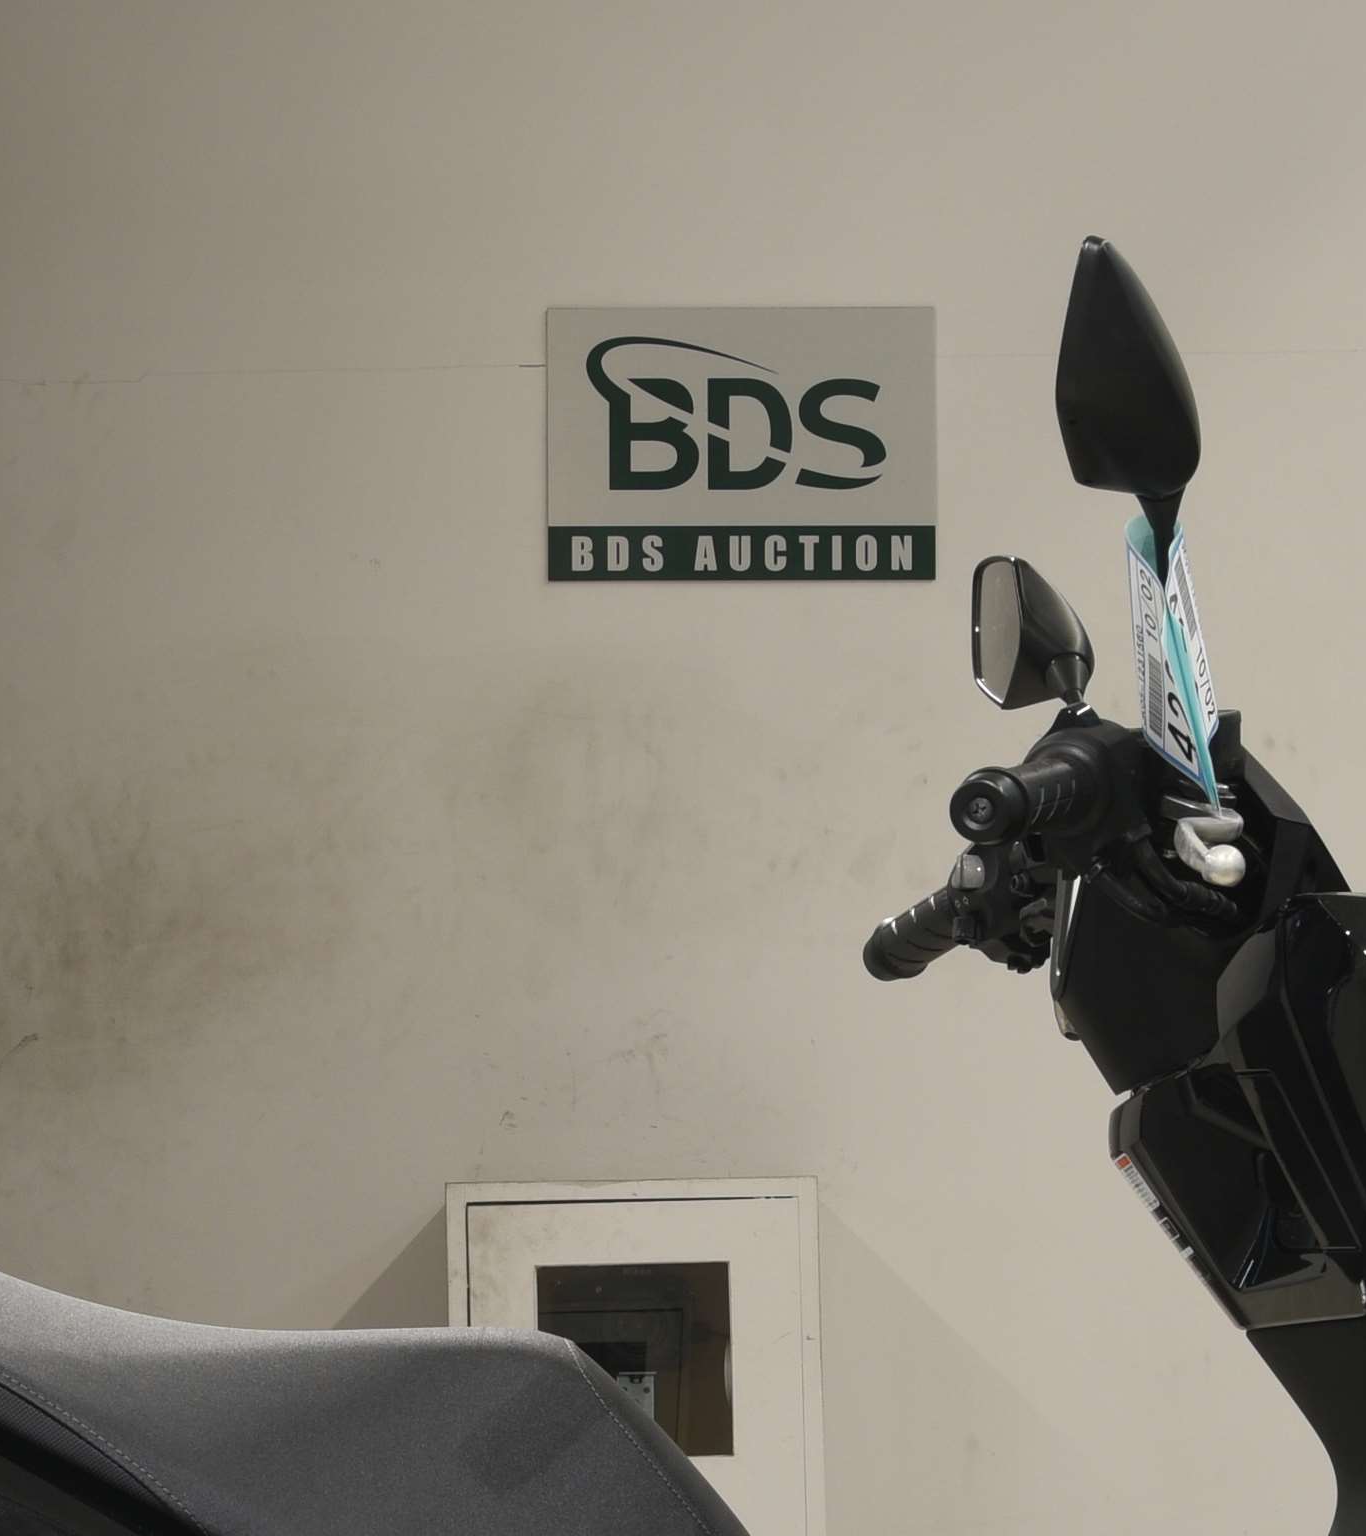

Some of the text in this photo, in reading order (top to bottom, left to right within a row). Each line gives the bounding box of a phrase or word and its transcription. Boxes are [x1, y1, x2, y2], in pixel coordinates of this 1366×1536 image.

[586, 336, 887, 490] BDS
[571, 534, 913, 572] BDS AUCTION
[1140, 568, 1158, 642] 10/02
